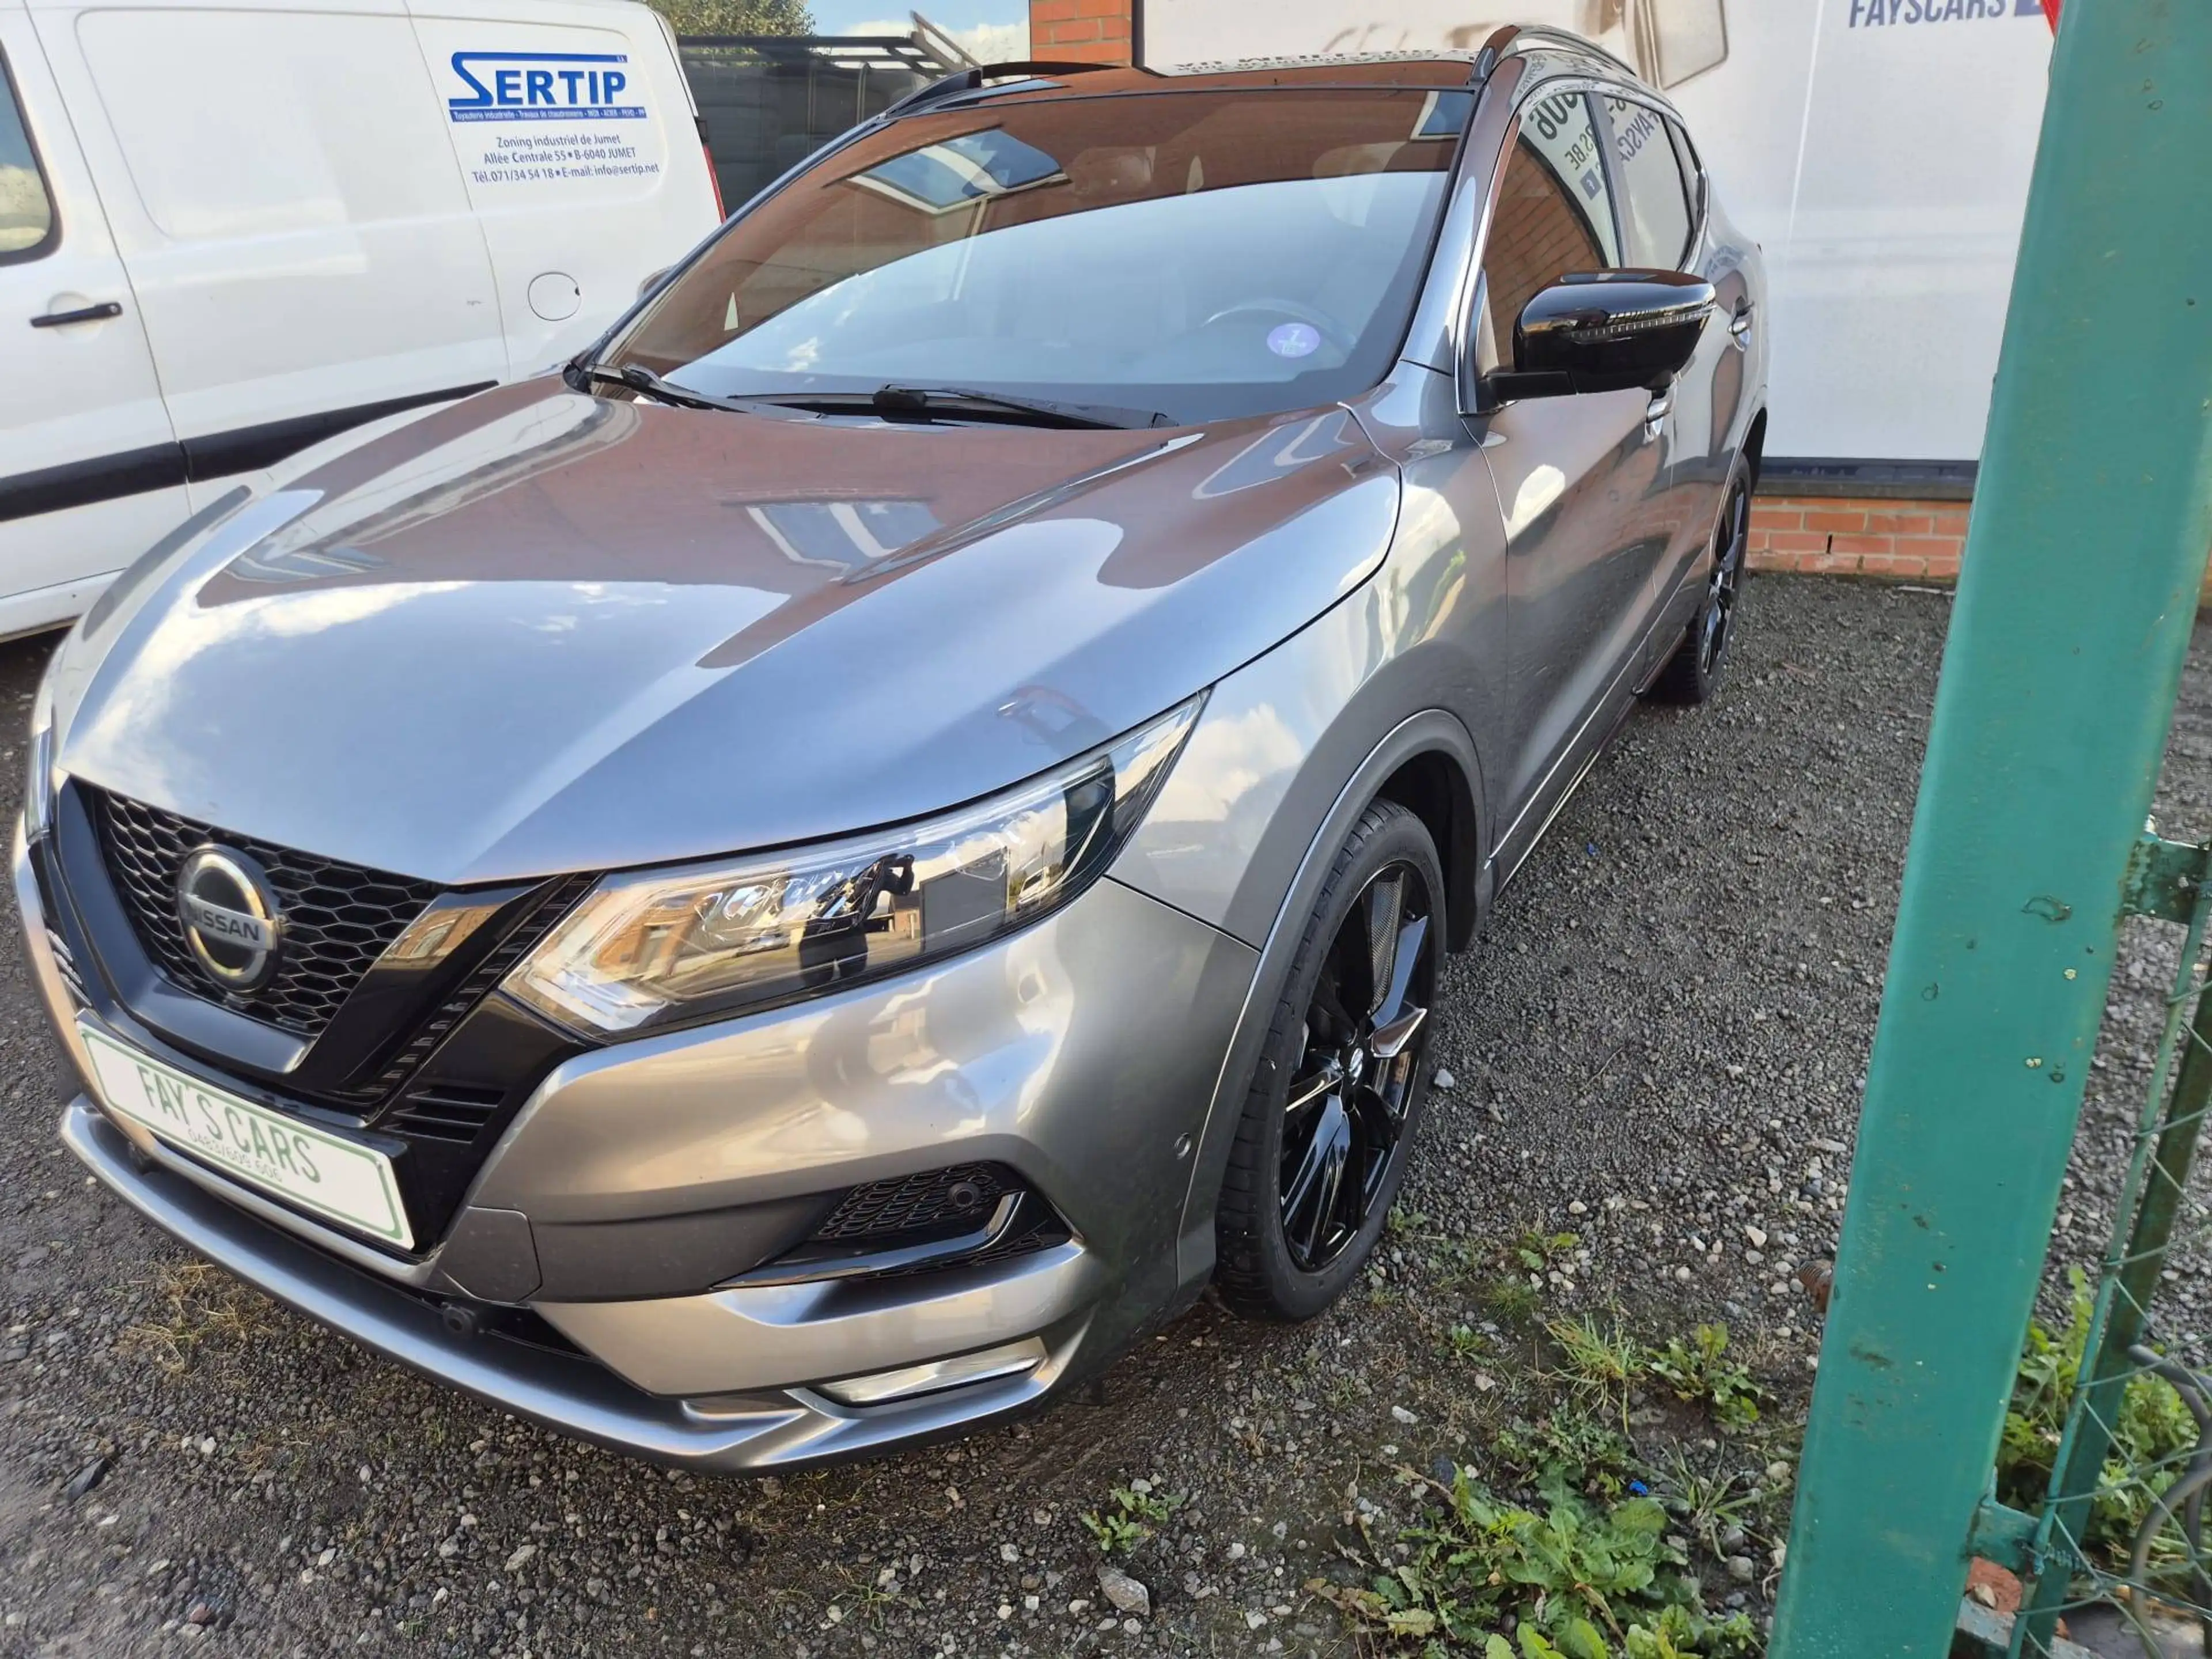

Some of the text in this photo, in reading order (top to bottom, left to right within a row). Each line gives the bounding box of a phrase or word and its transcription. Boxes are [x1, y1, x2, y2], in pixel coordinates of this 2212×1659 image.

[449, 51, 628, 108] SERTIP
[497, 134, 621, 150] Zoning industriel de Jumet
[484, 147, 636, 165] Allée Centrale 55 B-6040 JUMET
[528, 169, 540, 180] 54
[542, 168, 554, 179] 18
[135, 1064, 321, 1184] FAY'S CARS
